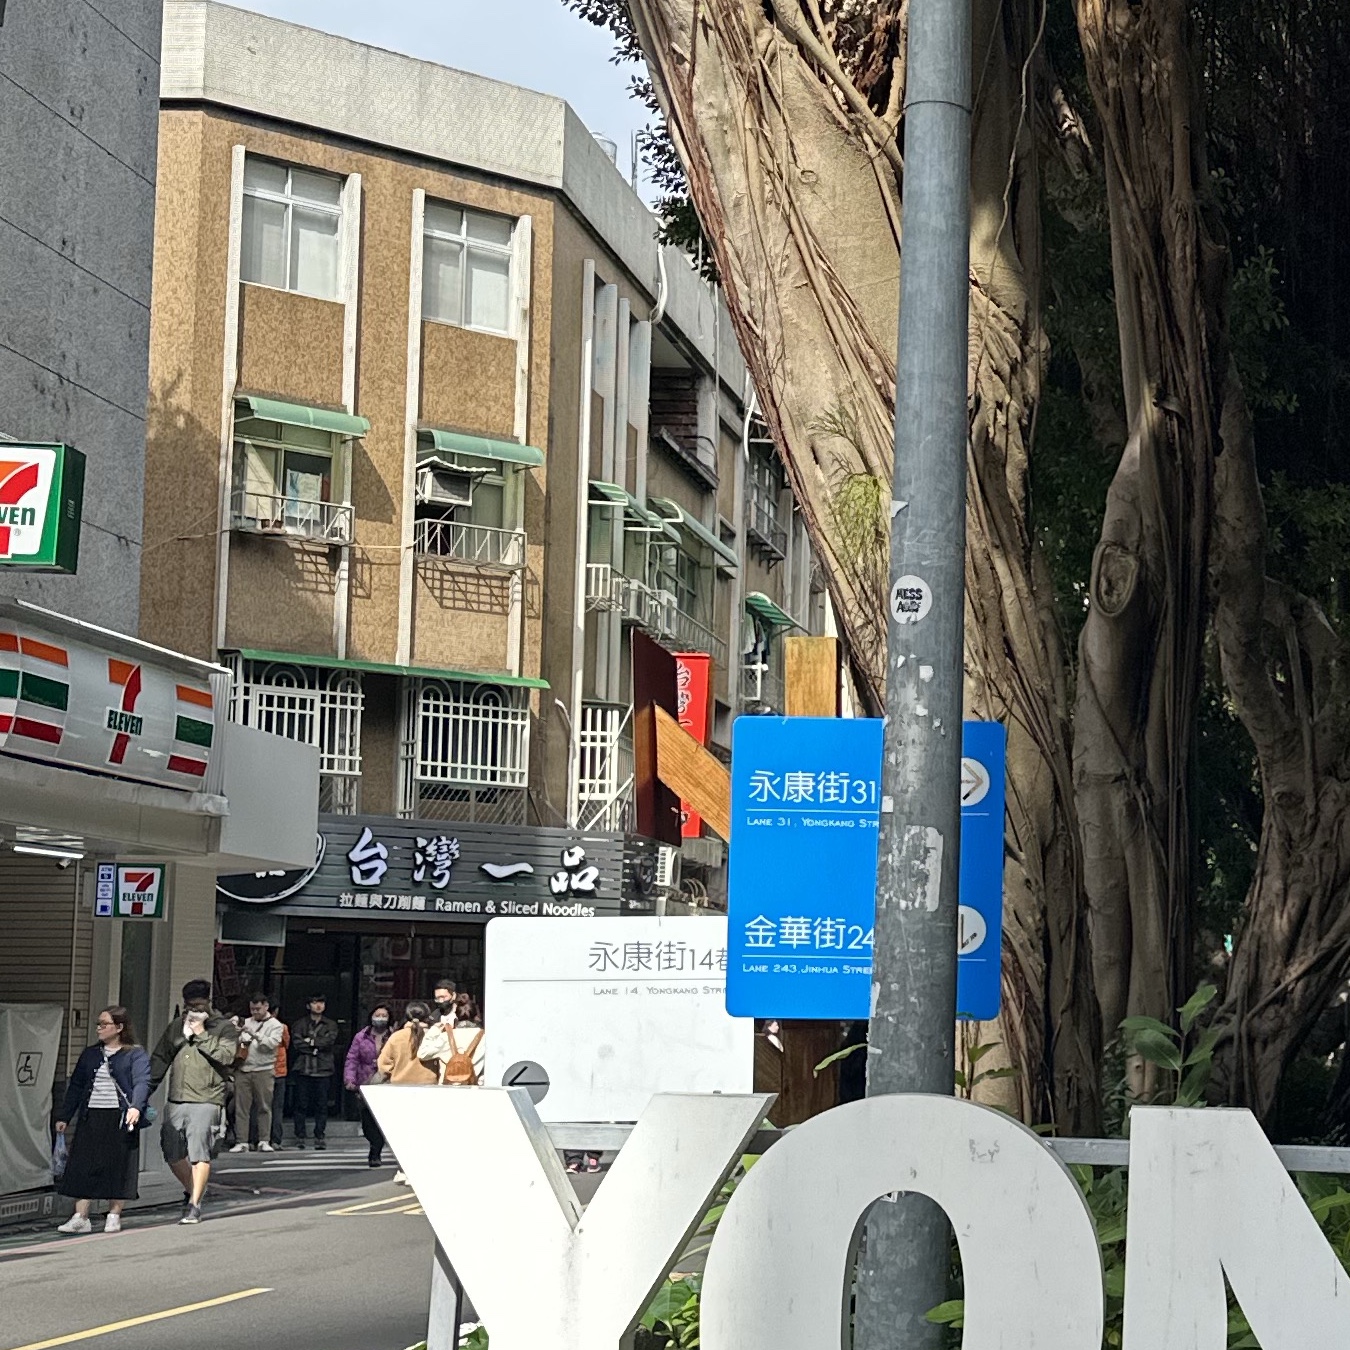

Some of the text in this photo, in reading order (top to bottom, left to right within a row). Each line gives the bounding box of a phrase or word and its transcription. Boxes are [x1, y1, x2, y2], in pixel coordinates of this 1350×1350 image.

[748, 770, 876, 804] 永康街31
[801, 816, 855, 828] YONGKANG
[859, 818, 880, 828] STR
[349, 827, 599, 894] 台灣一品
[435, 899, 481, 913] Ramen
[485, 901, 496, 914] &
[500, 901, 538, 915] Sliced
[543, 903, 595, 917] Noodles
[745, 914, 875, 949] 金華街24
[593, 987, 619, 995] LANE
[646, 986, 698, 995] YONGKANG
